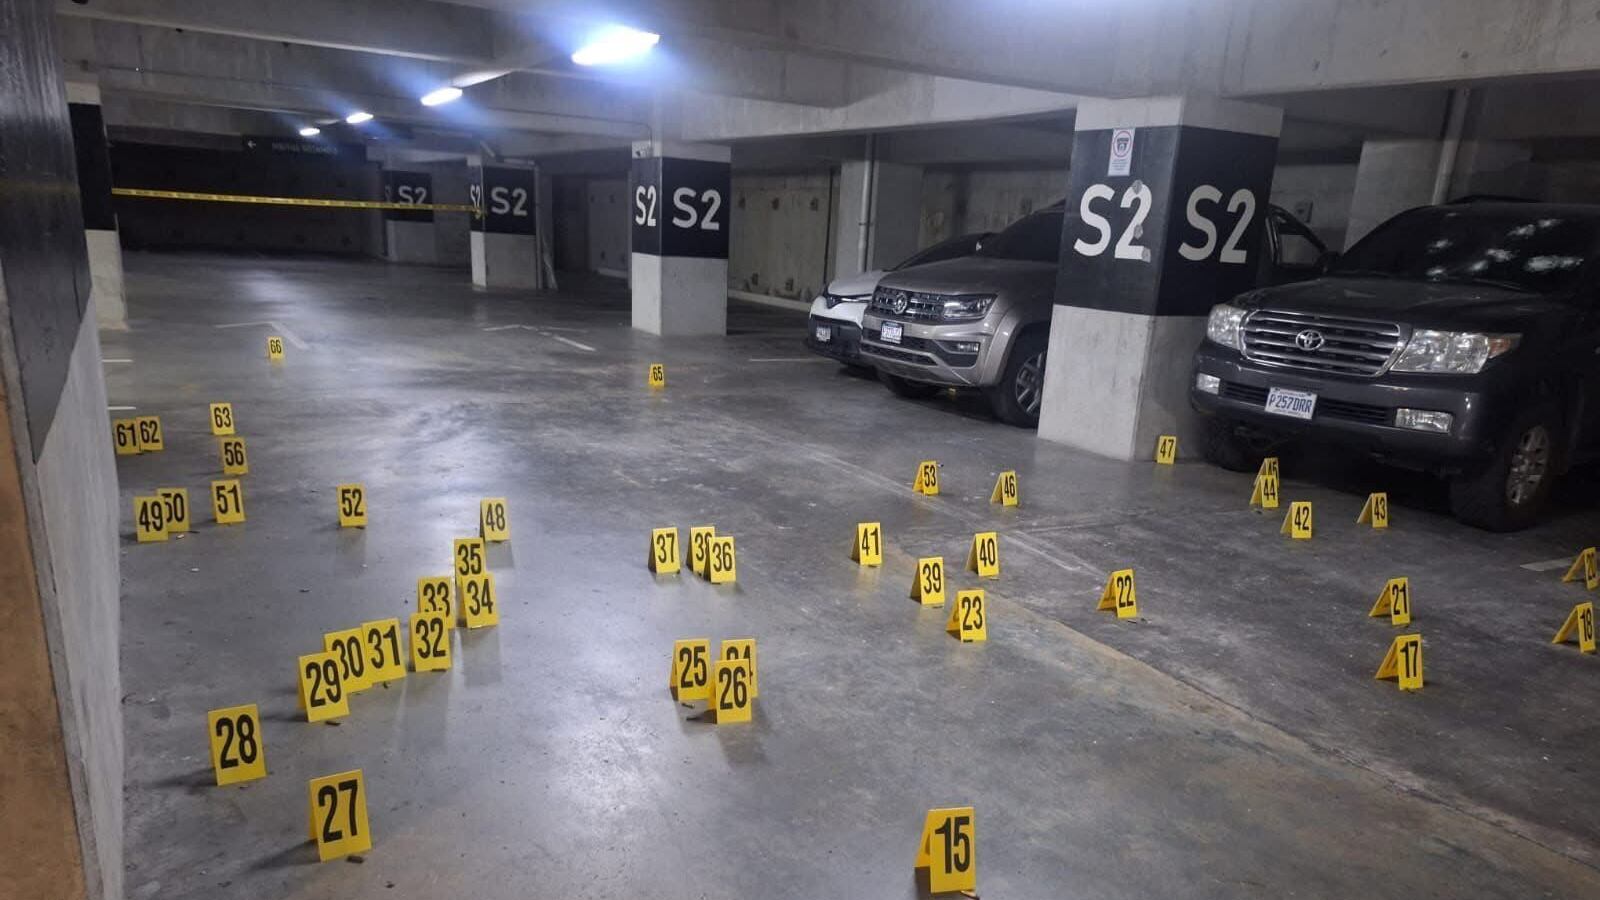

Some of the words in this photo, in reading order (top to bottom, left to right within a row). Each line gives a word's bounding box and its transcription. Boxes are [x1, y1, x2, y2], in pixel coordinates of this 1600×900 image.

[398, 185, 427, 205] S2
[491, 187, 528, 217] S2
[635, 185, 657, 227] S2
[672, 187, 721, 230] S2
[1074, 181, 1153, 262] S2
[1178, 184, 1256, 263] S2
[270, 339, 282, 354] 66
[652, 366, 663, 381] 65
[140, 420, 159, 443] 62
[214, 407, 231, 428] 63
[116, 423, 137, 447] 61
[1159, 438, 1175, 458] 47
[224, 443, 244, 466] 56
[923, 464, 937, 487] 53
[1003, 476, 1016, 498] 46
[1264, 478, 1276, 501] 44
[162, 493, 185, 522] 50
[216, 484, 240, 514] 51
[342, 488, 362, 517] 52
[1373, 496, 1386, 520] 43
[139, 501, 163, 532] 49
[485, 503, 505, 531] 48
[1294, 506, 1310, 531] 42
[656, 533, 676, 564] 37
[712, 542, 732, 572] 36
[861, 527, 880, 557] 41
[979, 537, 996, 566] 40
[457, 543, 482, 575] 35
[923, 562, 942, 594] 39
[1116, 575, 1134, 608] 22
[423, 581, 450, 618] 33
[466, 578, 493, 616] 34
[1391, 583, 1408, 615] 21
[961, 596, 983, 631] 23
[1580, 607, 1593, 642] 18
[368, 625, 401, 669] 31
[415, 617, 446, 659] 32
[331, 636, 364, 679] 30
[679, 646, 707, 688] 25
[1400, 641, 1417, 678] 17
[306, 661, 342, 708] 29
[719, 666, 747, 710] 26
[216, 714, 257, 769] 28
[318, 779, 359, 844] 27
[934, 816, 970, 874] 15
